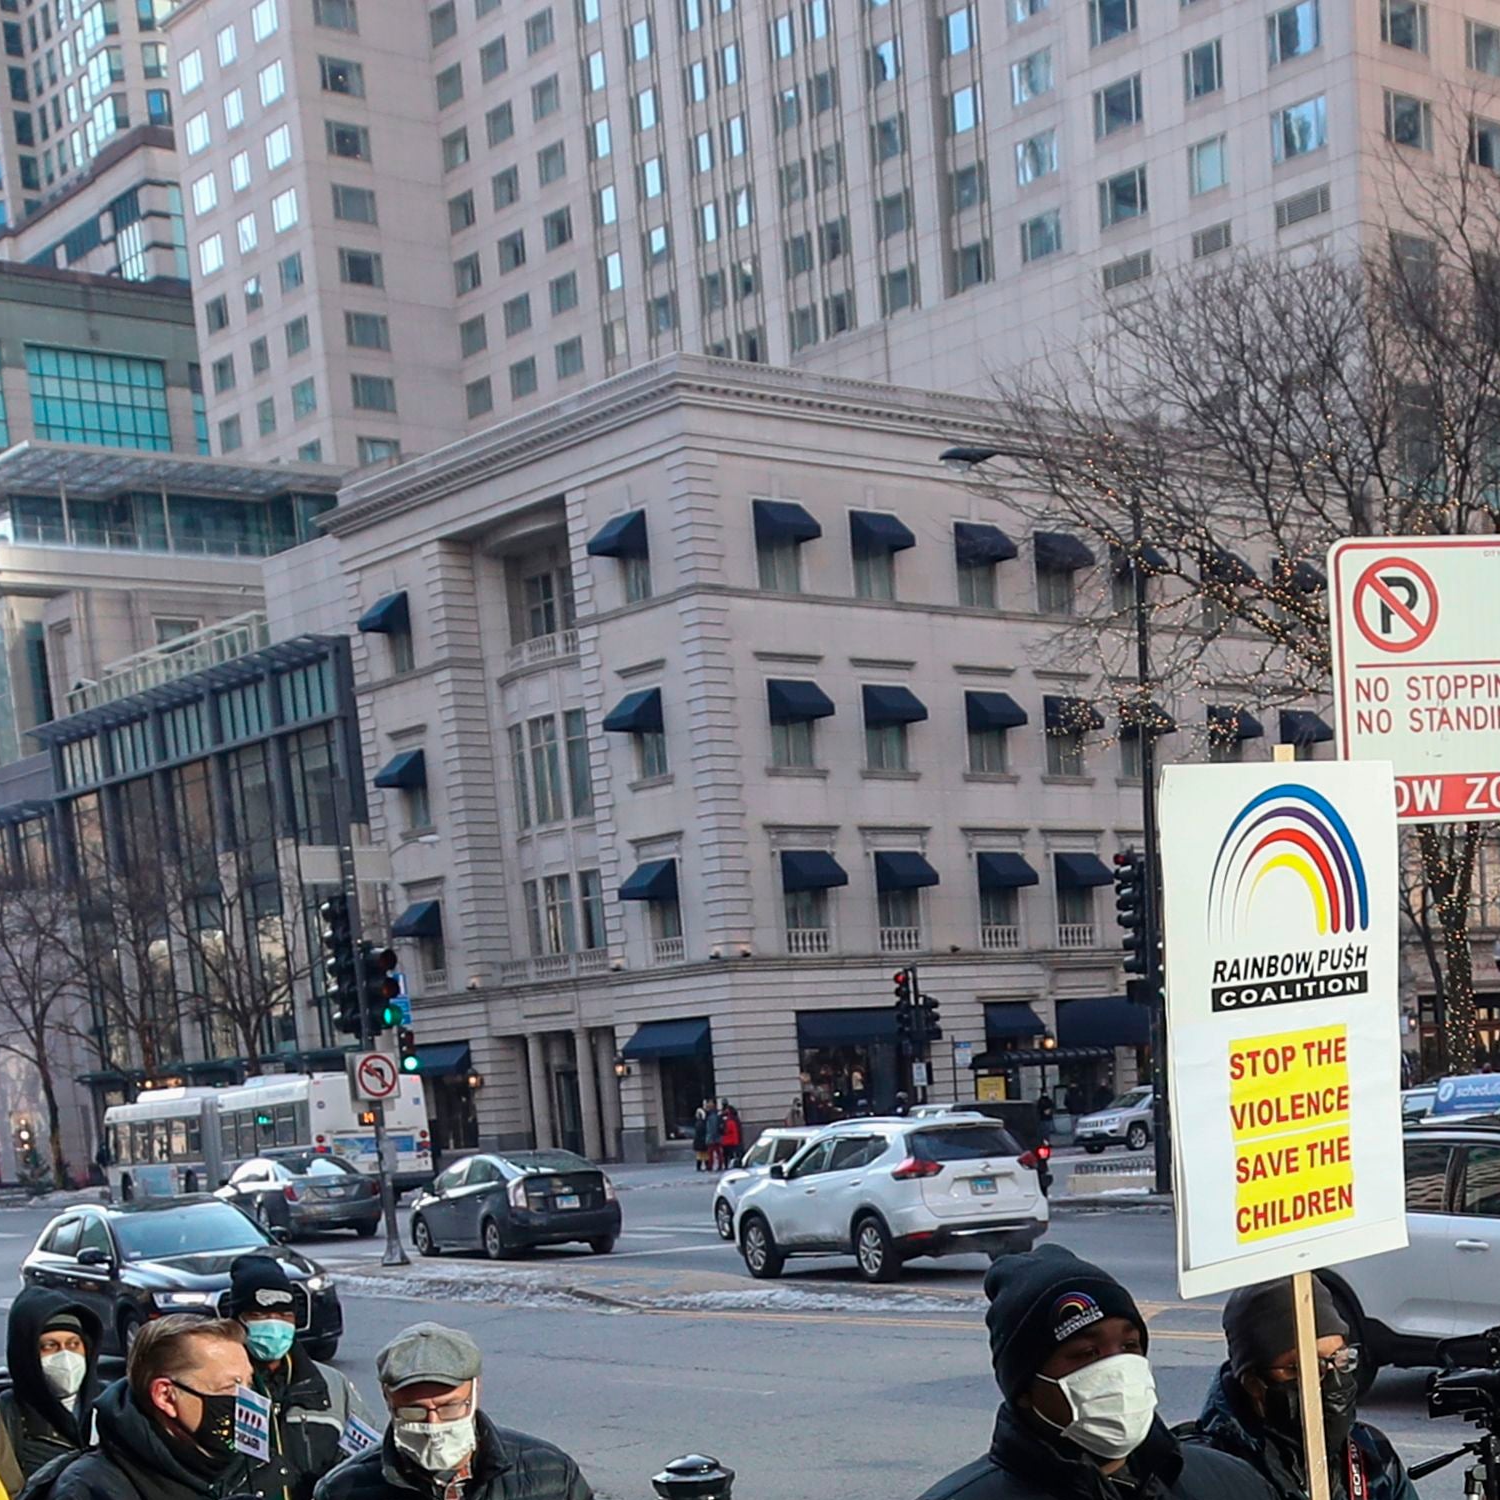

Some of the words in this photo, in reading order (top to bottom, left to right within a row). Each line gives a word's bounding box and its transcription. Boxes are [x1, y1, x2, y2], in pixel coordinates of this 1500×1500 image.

[1355, 677, 1390, 702] NO
[1357, 708, 1392, 734] NO
[1395, 779, 1442, 813] OW
[1219, 976, 1361, 1007] COALITION
[1230, 1045, 1296, 1080] STOP
[1303, 1037, 1347, 1068] THE
[1230, 1085, 1349, 1131] VIOLENCE
[1236, 1147, 1299, 1184] SAVE
[1306, 1136, 1351, 1169] THE
[1236, 1183, 1353, 1234] CHILDREN
